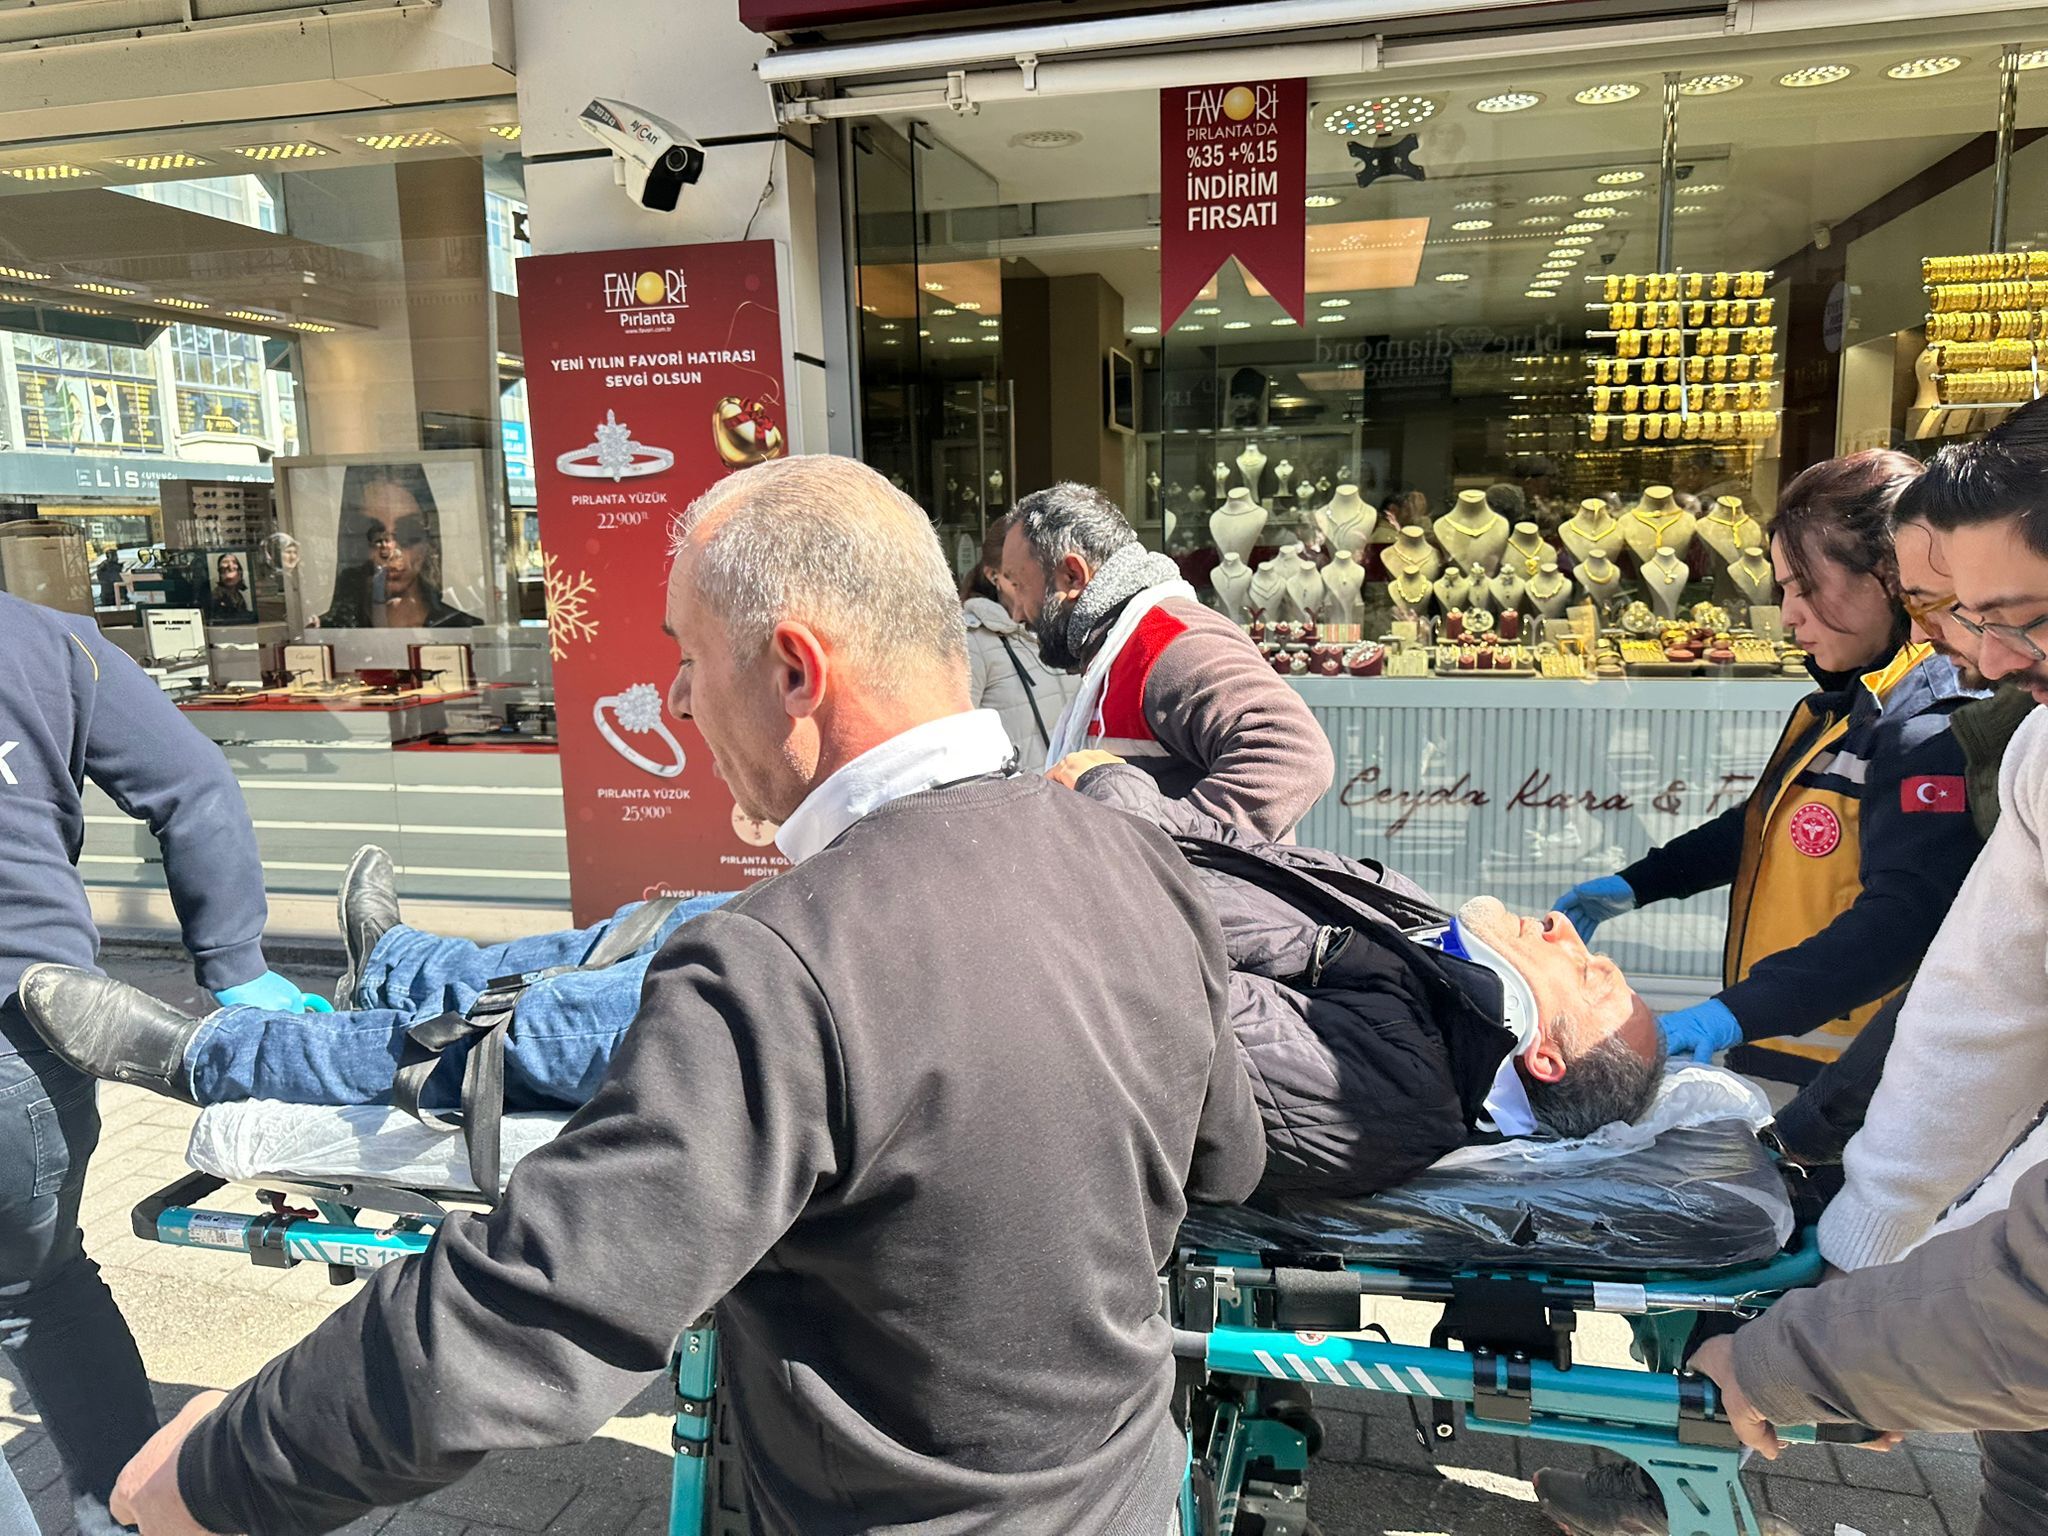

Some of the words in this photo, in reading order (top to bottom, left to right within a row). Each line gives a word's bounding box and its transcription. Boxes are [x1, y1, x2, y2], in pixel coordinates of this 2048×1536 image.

[1187, 122, 1278, 142] PIRLANTA'DA
[1187, 144, 1224, 169] %35
[1228, 140, 1278, 165] +%15
[1187, 167, 1278, 201] İNDİRİM
[1188, 201, 1278, 232] FIRSATI
[619, 311, 675, 327] Pırlanta
[551, 354, 584, 372] YENİ
[587, 354, 625, 370] YILIN
[628, 350, 683, 367] FAVORİ
[687, 349, 757, 365] HATIRASI
[605, 371, 648, 388] SEVGİ
[652, 371, 702, 386] OLSUN
[571, 494, 626, 506] PIRLANTA
[628, 493, 667, 504] YÜZÜK
[597, 788, 650, 799] PIRLANTA
[653, 788, 690, 799] YÜZÜK
[1341, 766, 1490, 838] Ceyda
[1507, 768, 1634, 812] Kara
[1653, 779, 1688, 815] &
[720, 855, 768, 865] PIRLANTA
[769, 857, 792, 866] KOL
[340, 1245, 369, 1265] ES
